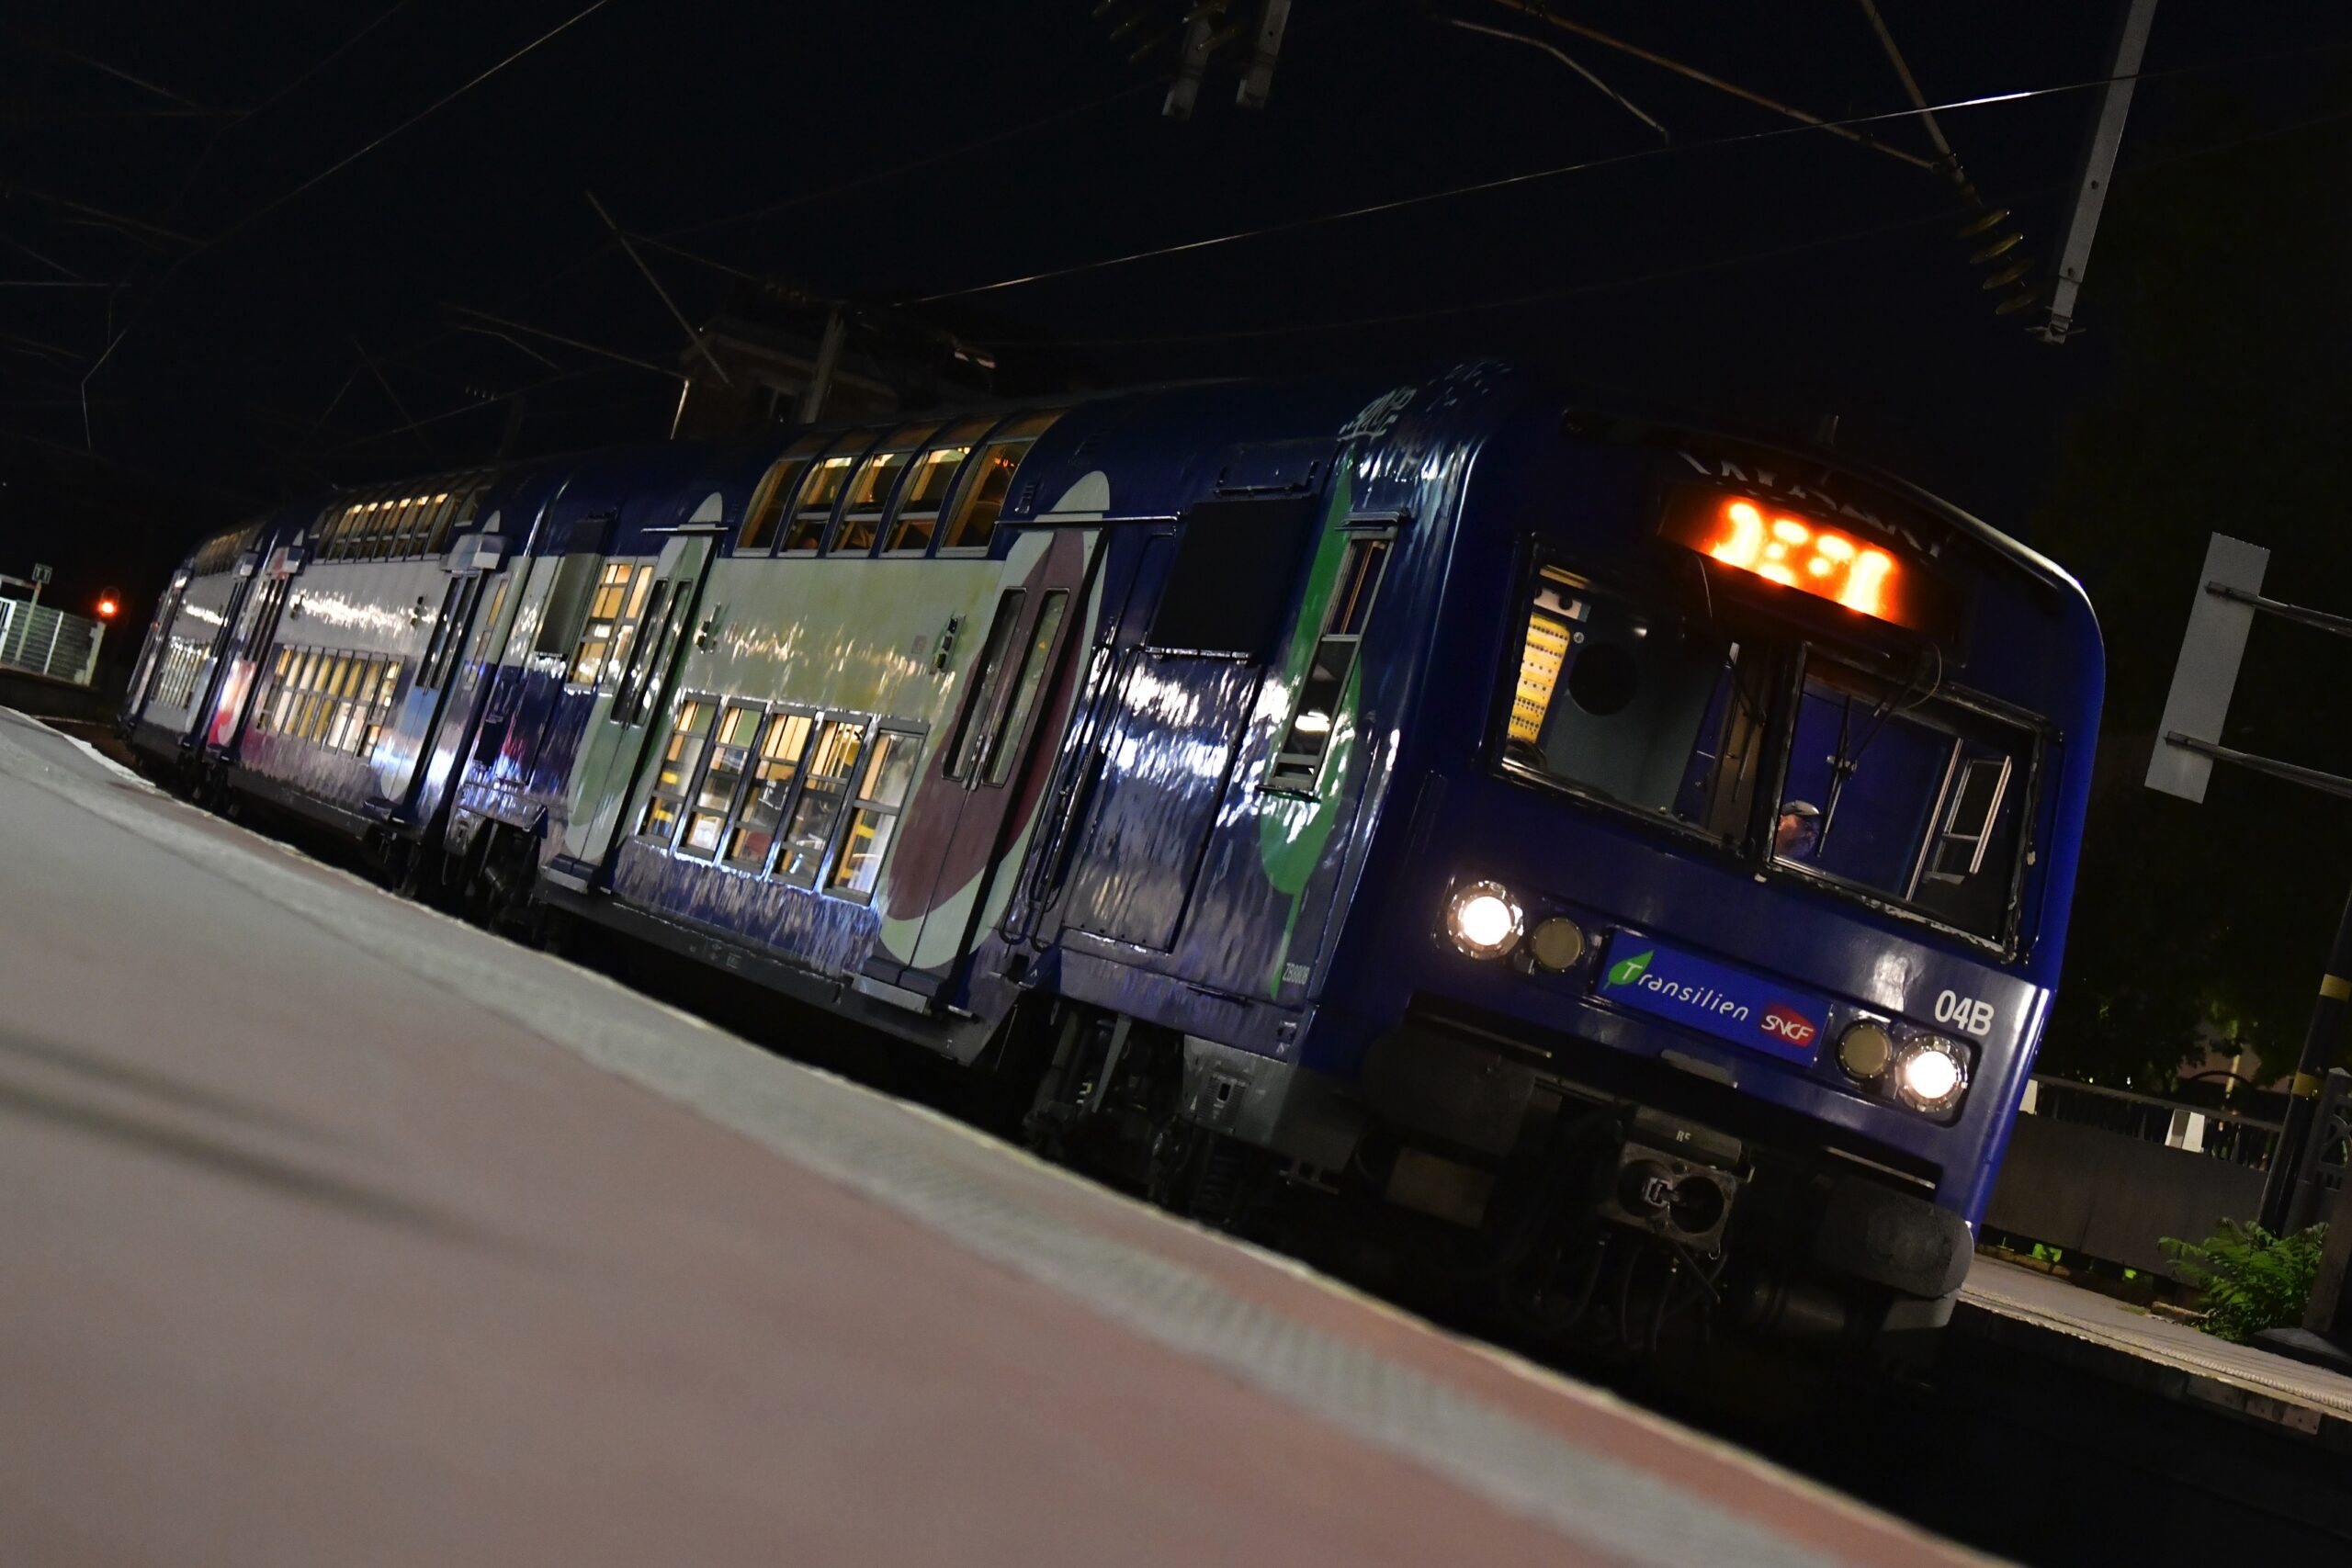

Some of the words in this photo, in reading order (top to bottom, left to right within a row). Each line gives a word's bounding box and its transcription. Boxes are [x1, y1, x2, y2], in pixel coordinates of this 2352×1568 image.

[1622, 962, 1748, 1021] Transilien
[1934, 989, 1993, 1035] 04B
[1761, 1014, 1814, 1040] SNCF
